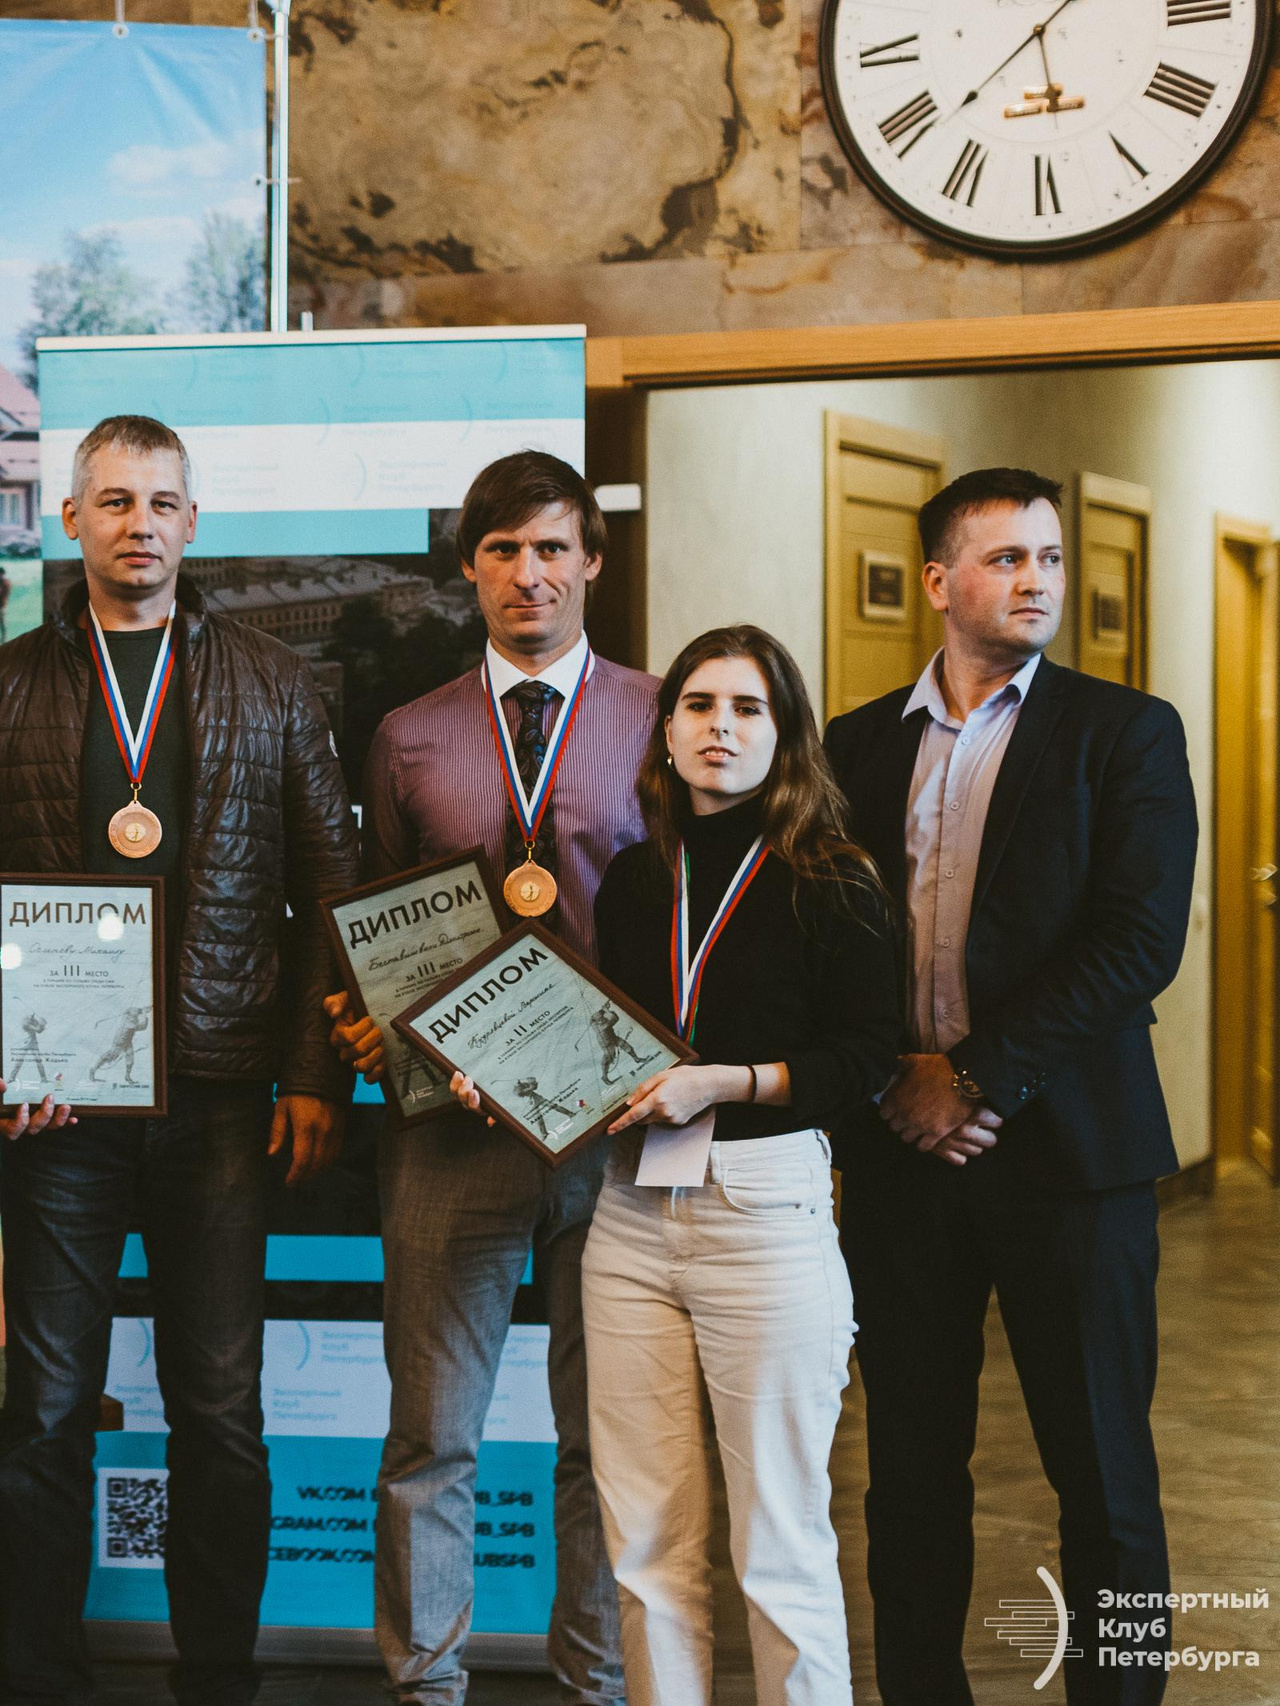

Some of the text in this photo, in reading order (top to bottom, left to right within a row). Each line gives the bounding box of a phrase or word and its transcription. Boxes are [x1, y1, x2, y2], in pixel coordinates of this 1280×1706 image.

[347, 880, 483, 949] ДИПЛОМ
[64, 965, 80, 976] III
[406, 957, 463, 982] ЗА III МЕСТО
[428, 947, 549, 1043] ДИПЛОМ
[506, 1038, 516, 1047] ЗА
[529, 1010, 551, 1028] МЕСТО
